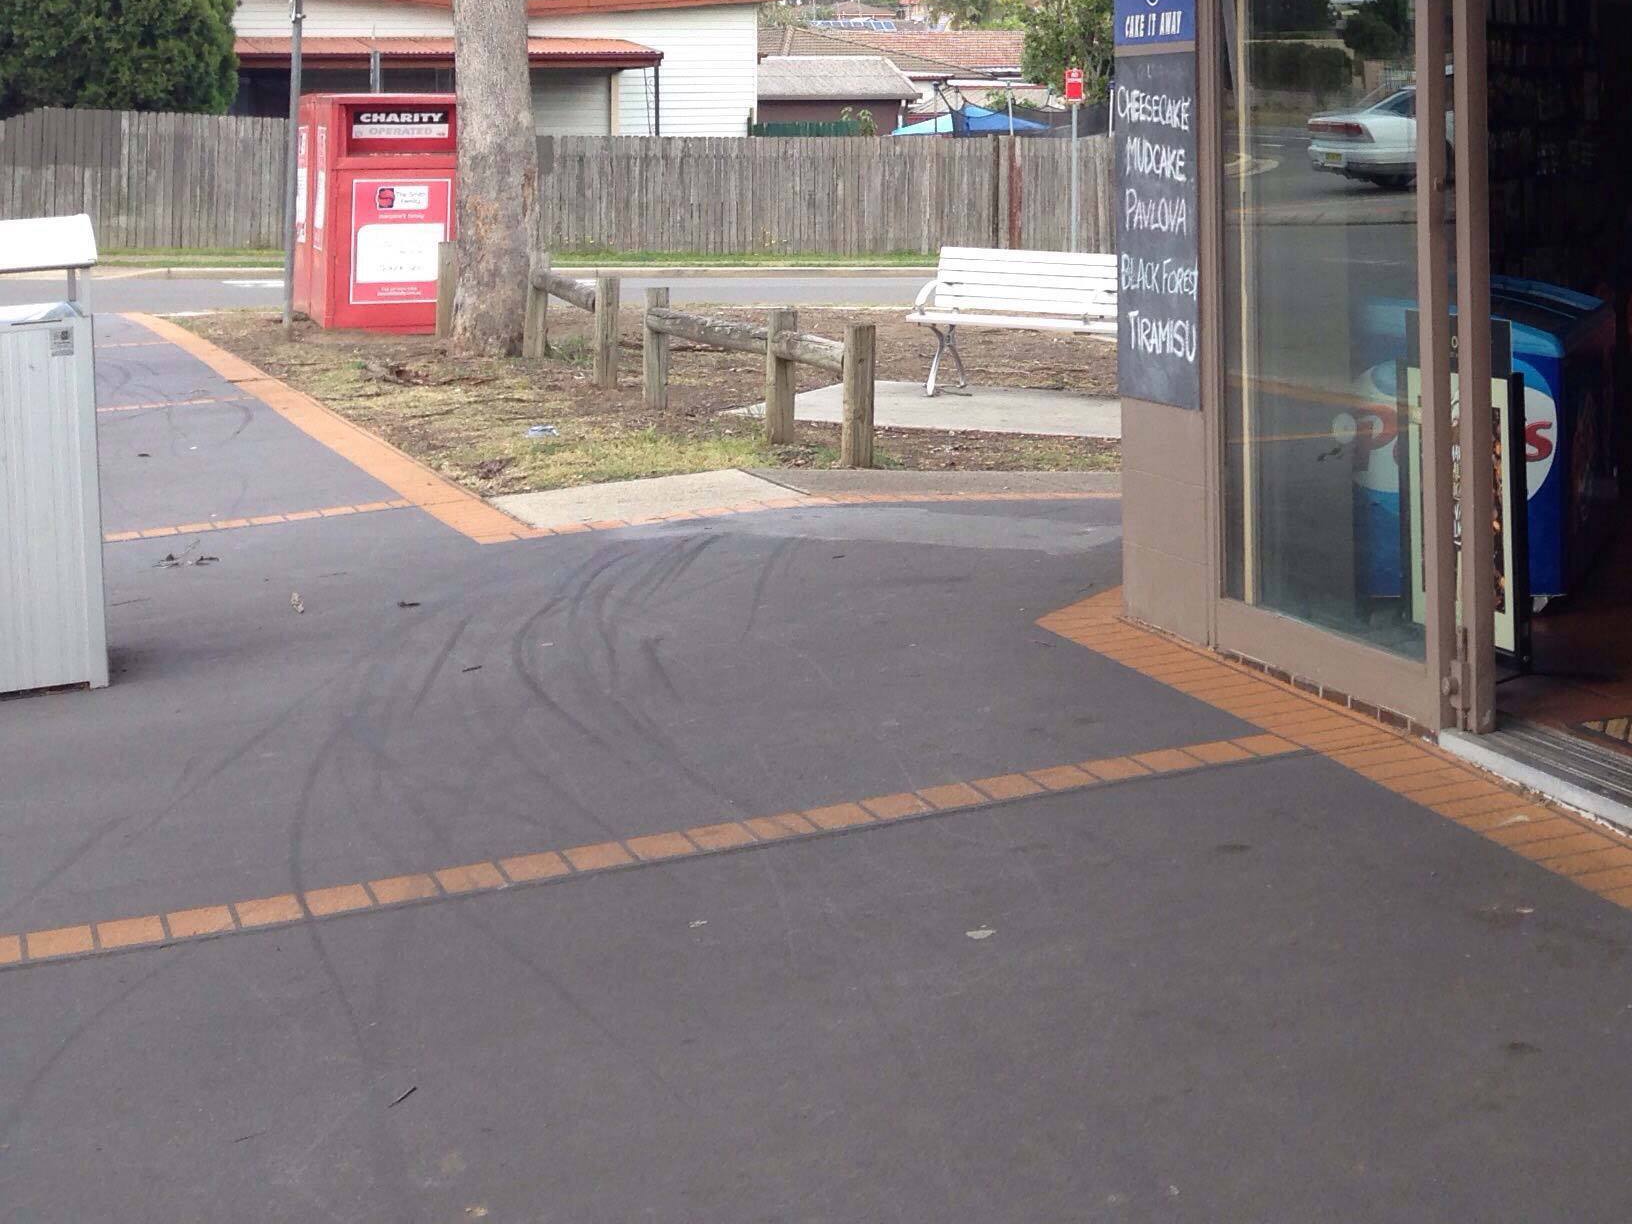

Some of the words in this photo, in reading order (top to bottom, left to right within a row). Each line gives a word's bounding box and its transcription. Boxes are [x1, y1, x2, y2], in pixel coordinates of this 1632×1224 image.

[1125, 13, 1145, 39] CAKE
[1147, 13, 1156, 37] IT
[1159, 10, 1182, 36] AWAY
[359, 112, 444, 123] CHARITY
[1117, 85, 1191, 131] CHEESECAKE
[368, 126, 433, 137] OPERATED
[1125, 135, 1188, 182] MUDCAKE
[1120, 252, 1160, 294] BLACK
[1127, 310, 1197, 363] TIRAMISU
